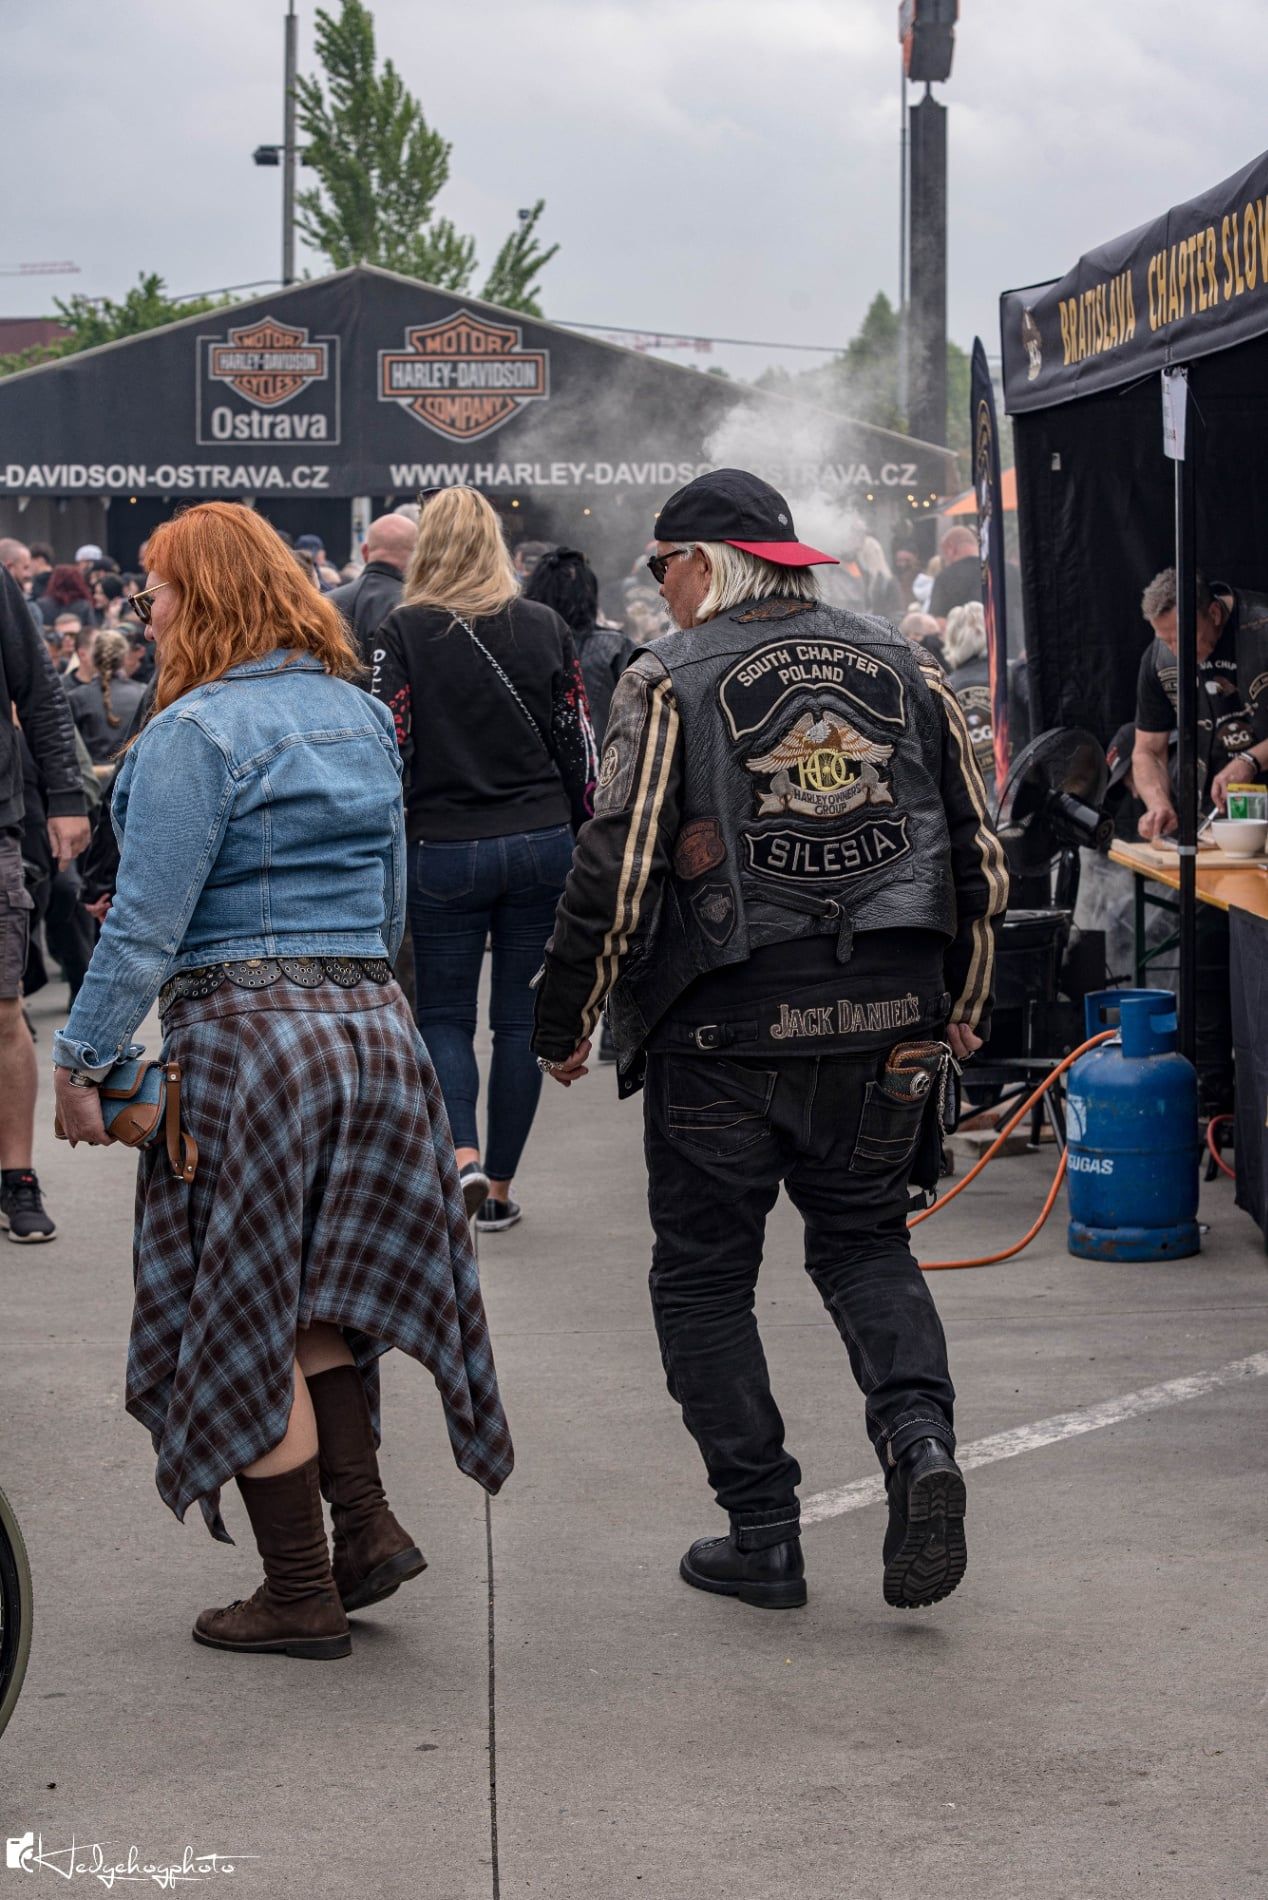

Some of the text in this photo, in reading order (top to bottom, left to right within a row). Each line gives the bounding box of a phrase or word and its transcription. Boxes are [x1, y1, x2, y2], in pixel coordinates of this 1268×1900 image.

[1058, 269, 1136, 367] BRATISLAVA
[1147, 226, 1219, 332] CHAPTER
[242, 327, 295, 347] MOTOR
[424, 325, 503, 353] MOTOR
[219, 352, 317, 371] HARLEY-DAVIDSON
[391, 361, 537, 388] HARLEY-DAVIDSON
[241, 376, 294, 397] CYCLES
[211, 406, 327, 439] Ostrava
[425, 397, 504, 430] COMPANY
[736, 645, 879, 687] SOUTH CHAPTER
[777, 664, 845, 685] POLAND
[794, 783, 862, 806] HARLEY OWNERS
[814, 804, 847, 816] GROUP
[767, 827, 897, 873] SILESIA
[769, 1003, 835, 1040] JACK
